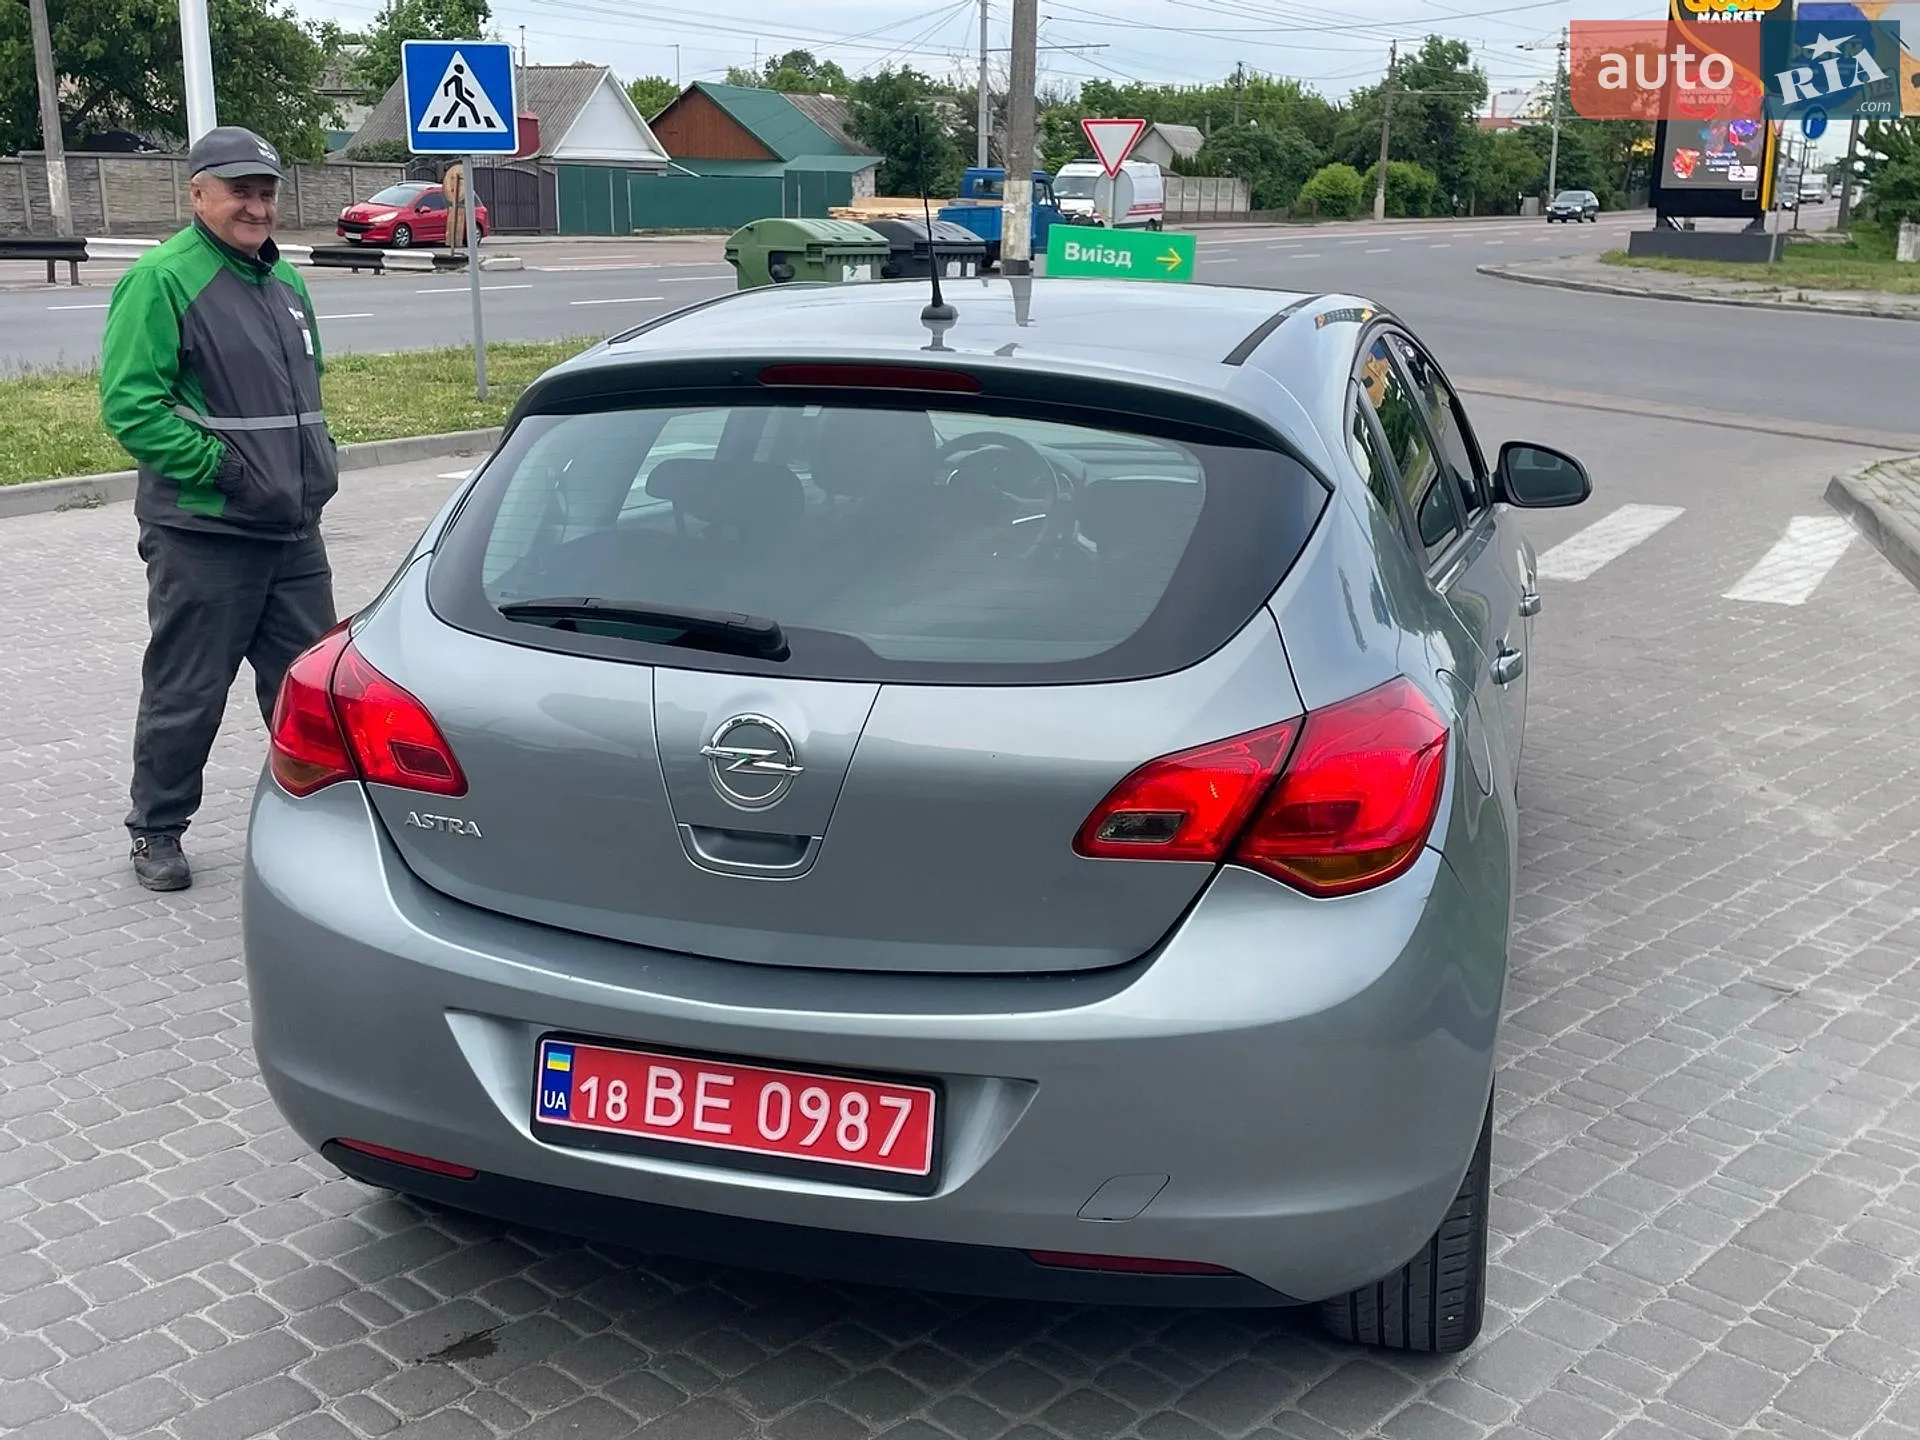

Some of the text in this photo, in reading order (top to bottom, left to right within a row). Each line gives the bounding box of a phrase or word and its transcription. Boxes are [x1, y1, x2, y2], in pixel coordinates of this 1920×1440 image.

[1697, 10, 1765, 24] MARKET
[1065, 243, 1132, 268] Виїзд
[404, 811, 482, 838] ASTRA
[543, 1090, 567, 1111] UA
[579, 1065, 913, 1156] 18 BE 0987
